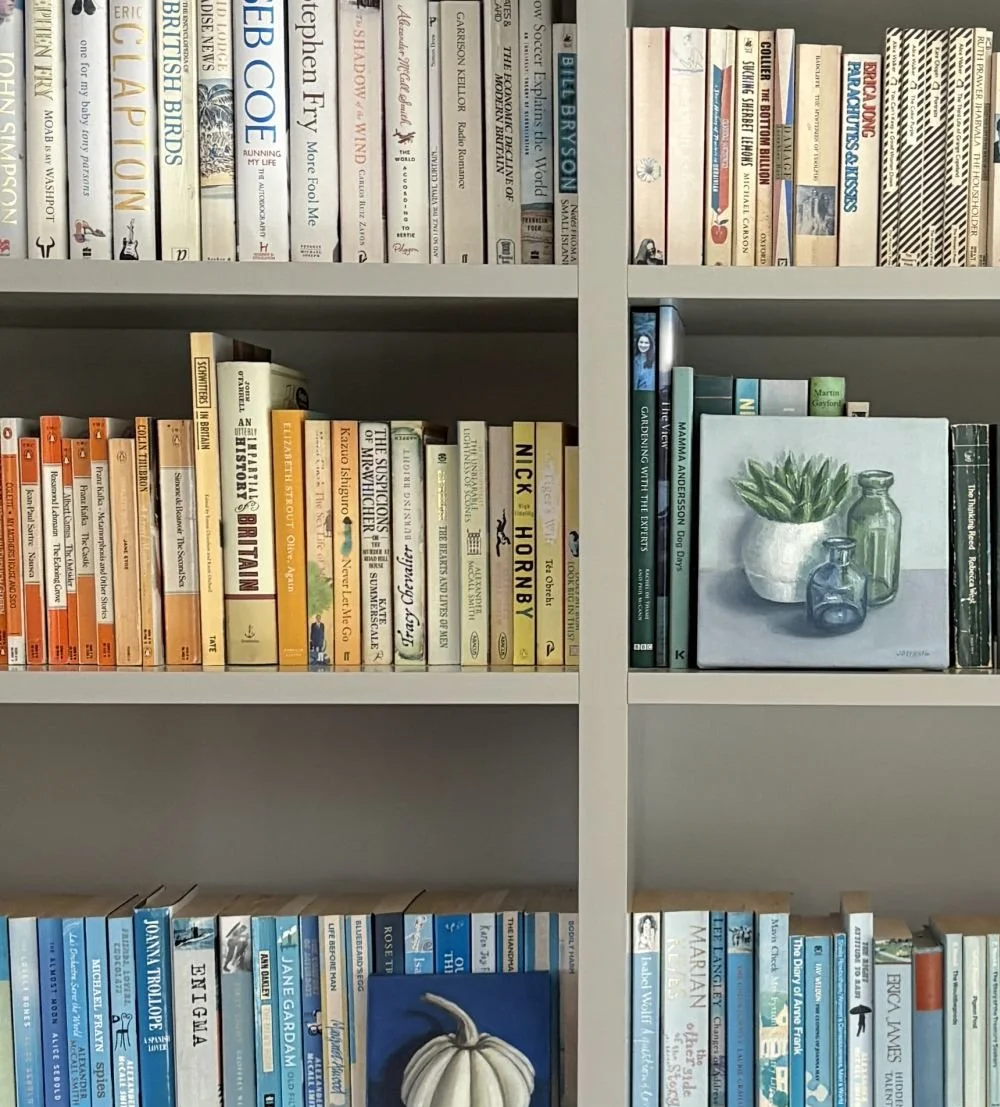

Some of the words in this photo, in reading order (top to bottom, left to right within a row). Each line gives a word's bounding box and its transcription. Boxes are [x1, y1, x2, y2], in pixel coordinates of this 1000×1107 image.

[114, 6, 143, 18] ERIC
[80, 40, 89, 58] one
[162, 1, 182, 91] BRITISH
[761, 42, 771, 80] COLLIER
[81, 62, 91, 77] for
[561, 56, 574, 98] BILL
[863, 62, 877, 102] ERICA
[77, 81, 89, 97] my
[244, 60, 276, 144] COE
[761, 89, 769, 102] THE
[846, 61, 860, 150] PARACHUTES
[79, 101, 91, 126] baby
[113, 23, 149, 211] CLAPTON
[164, 100, 182, 165] BIRDS
[760, 105, 770, 146] BOTTOM
[863, 104, 876, 137] JONG
[78, 130, 90, 152] tony
[561, 105, 576, 191] BRYSON
[846, 152, 857, 165] &
[81, 156, 90, 197] parsons
[760, 149, 770, 185] BILLION
[844, 167, 858, 212] KISSES
[198, 361, 209, 404] SCHWITTERS
[199, 411, 209, 419] IN
[199, 421, 210, 450] BRITAIN
[340, 428, 351, 463] Kazuo
[677, 422, 686, 462] MAMMA
[516, 445, 532, 494] NICK
[80, 485, 89, 503] Franz
[338, 468, 351, 515] Ishiguro
[677, 466, 686, 525] ANDERSSON
[81, 504, 89, 526] Kafka
[237, 514, 259, 591] BRITAIN
[675, 530, 685, 548] Dog
[341, 559, 351, 588] Never
[515, 527, 533, 620] HORNBY
[675, 550, 685, 571] Days
[342, 590, 352, 607] Let
[342, 609, 352, 624] Me
[342, 626, 351, 642] Go
[143, 920, 160, 965] JOANNA
[794, 938, 802, 957] The
[91, 959, 102, 1011] MICHAEL
[282, 956, 293, 996] JANE
[792, 959, 802, 985] Diary
[146, 968, 162, 1030] TROLLOPE
[191, 964, 207, 1047] ENIGMA
[794, 987, 803, 997] of
[887, 974, 899, 1013] ERICA
[794, 999, 802, 1025] Anne
[93, 1014, 104, 1052] FRAYN
[284, 1000, 296, 1067] GARDAM
[794, 1027, 803, 1055] Frank
[886, 1018, 900, 1063] JAMES
[93, 1062, 108, 1098] spies
